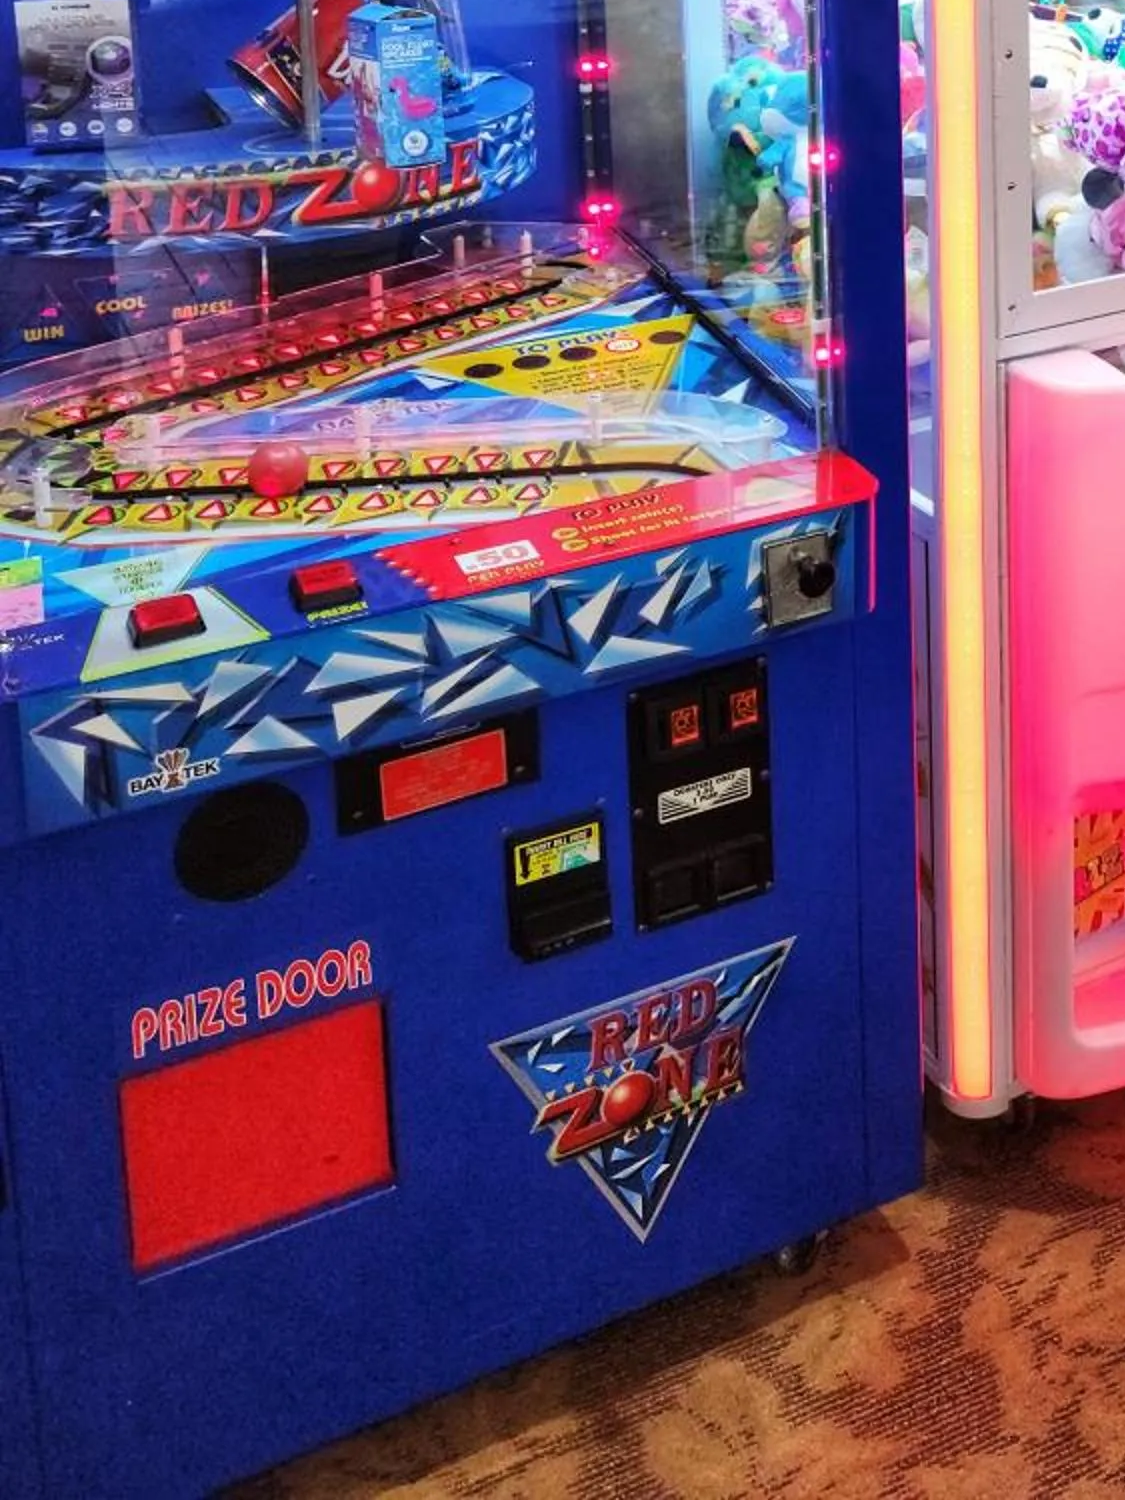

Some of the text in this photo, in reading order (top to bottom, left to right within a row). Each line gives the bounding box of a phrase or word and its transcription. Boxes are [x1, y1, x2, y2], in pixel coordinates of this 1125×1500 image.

[104, 141, 482, 238] RED ZONE
[23, 295, 233, 343] WIN COOL PRIZES!
[572, 508, 601, 521] TO
[581, 516, 628, 533] Insert
[467, 558, 545, 587] PER PLAY
[130, 759, 217, 794] BAY TEK
[131, 939, 373, 1059] PRIZE DOOR
[586, 977, 717, 1073] RED
[540, 1027, 743, 1157] ZONE
